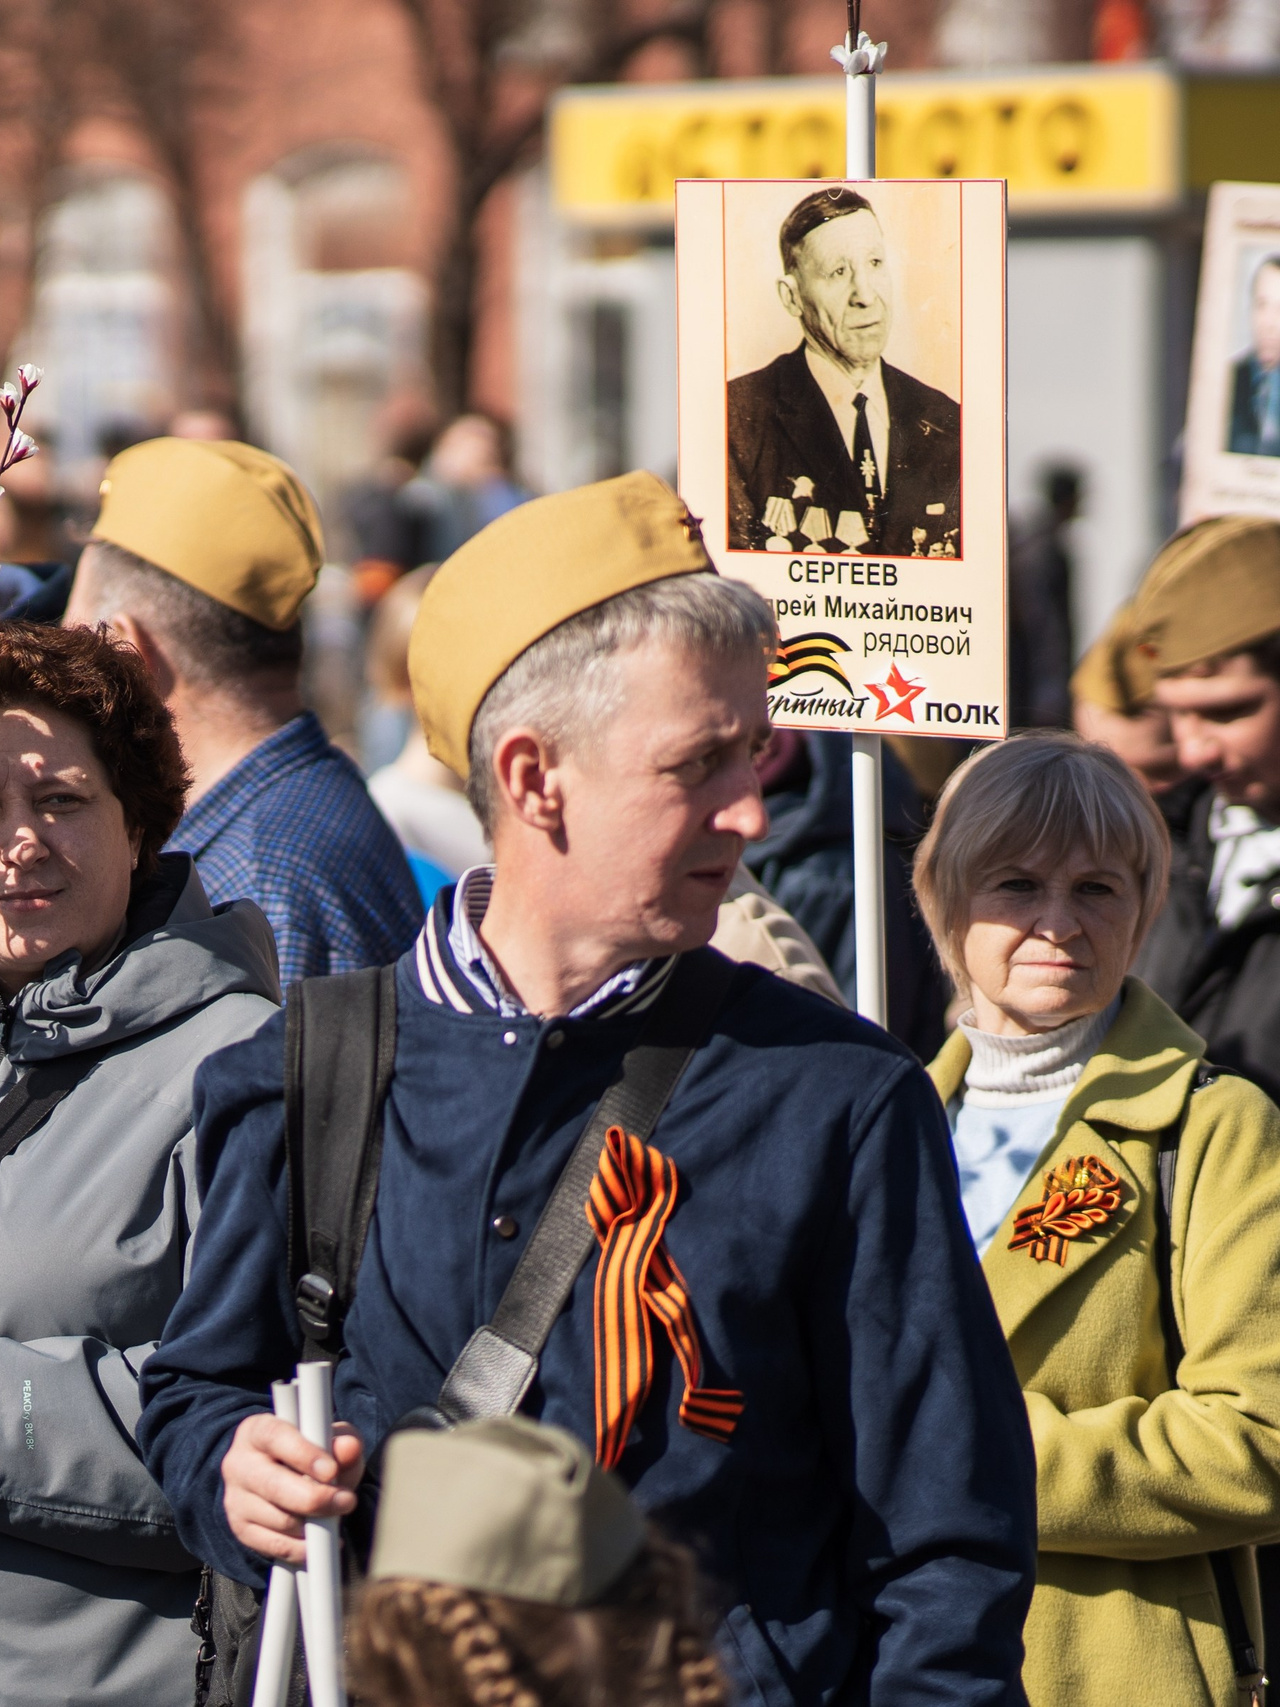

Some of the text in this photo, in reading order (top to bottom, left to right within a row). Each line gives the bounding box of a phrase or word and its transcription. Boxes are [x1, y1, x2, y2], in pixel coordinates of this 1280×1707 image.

[788, 559, 899, 586] СЕРГЕЕВ
[765, 594, 973, 624] рей Михайлович
[863, 629, 971, 658] рядовой
[766, 687, 870, 721] ертный
